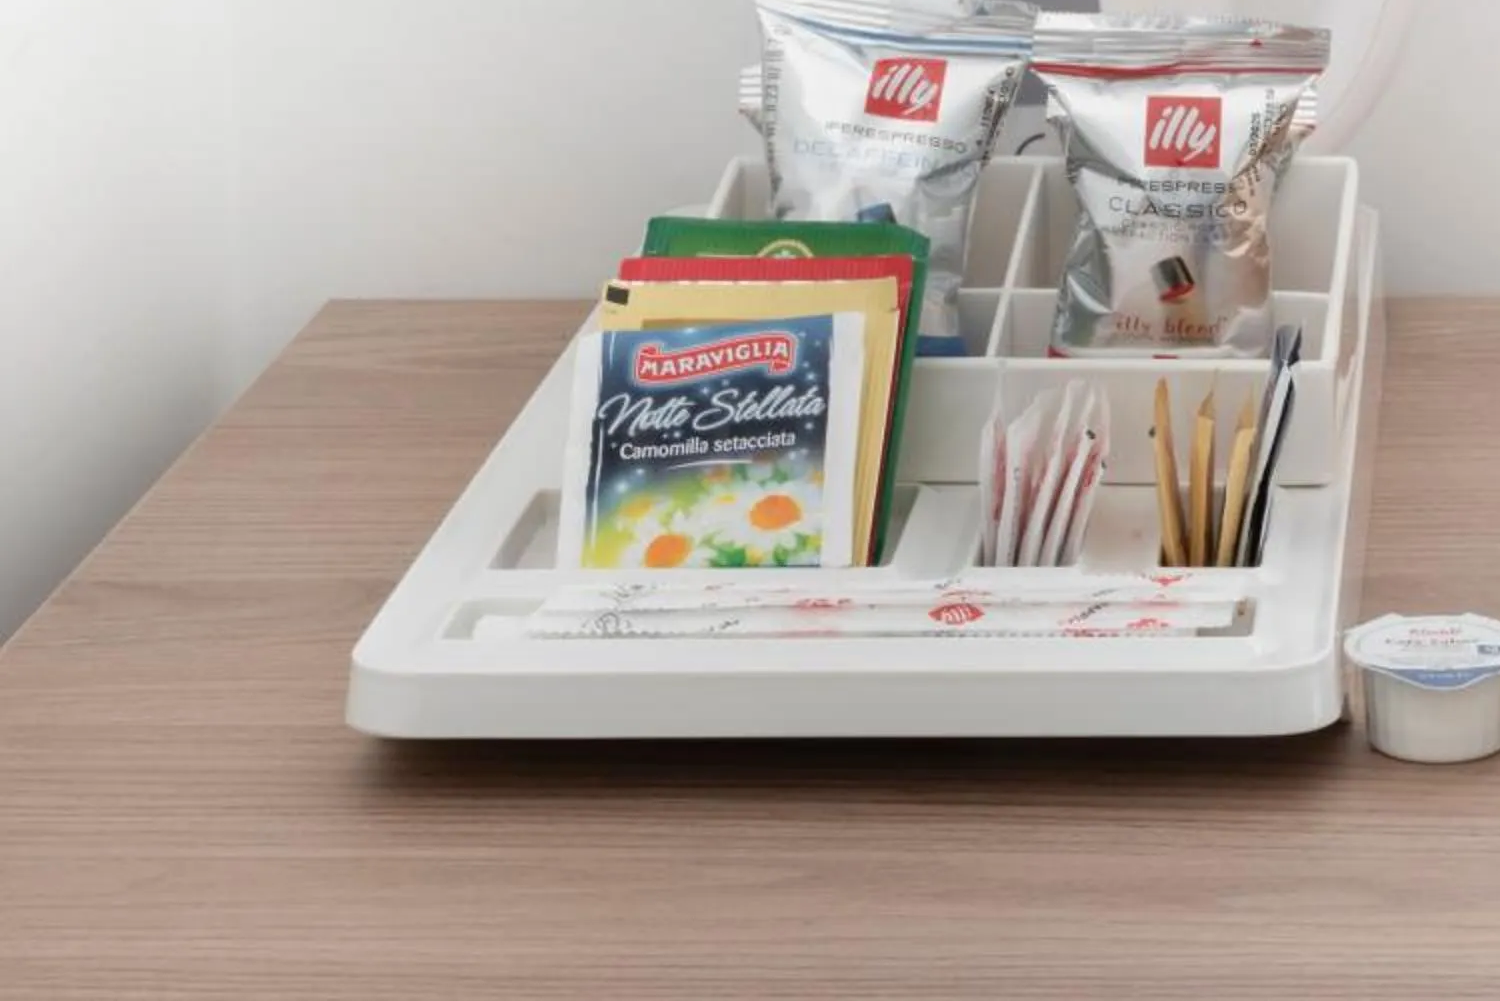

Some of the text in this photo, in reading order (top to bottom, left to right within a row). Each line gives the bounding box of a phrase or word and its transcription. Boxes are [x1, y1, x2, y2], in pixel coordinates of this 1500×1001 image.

[871, 64, 938, 117] illy
[1149, 103, 1217, 163] illy
[1108, 195, 1248, 219] CLASSICO
[638, 339, 790, 377] MARAVIGLIA
[600, 384, 826, 437] Notte Stellata
[619, 431, 796, 462] Camomilla setacciata
